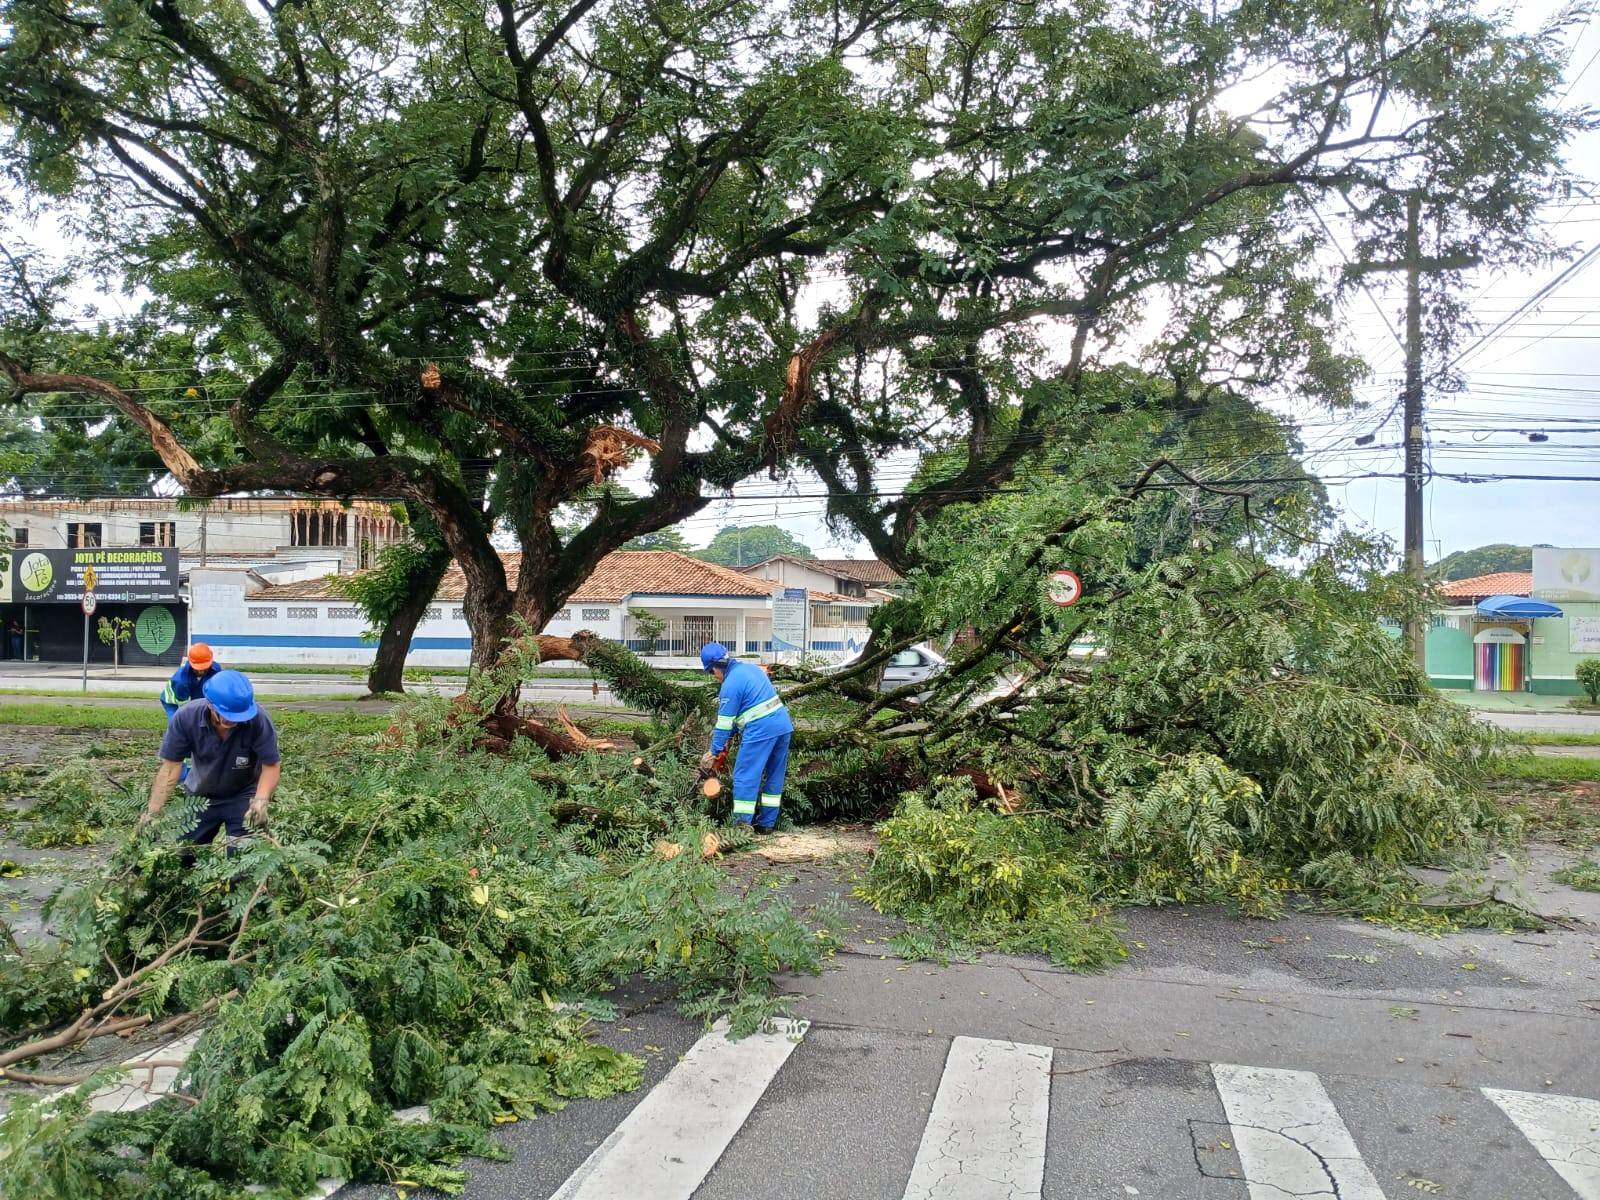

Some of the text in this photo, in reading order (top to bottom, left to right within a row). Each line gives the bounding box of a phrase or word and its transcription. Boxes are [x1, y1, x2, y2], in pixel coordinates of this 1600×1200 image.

[74, 550, 163, 565] JOTA PÊ DECORAÇÕES
[23, 557, 50, 581] Jota
[85, 595, 94, 607] 50
